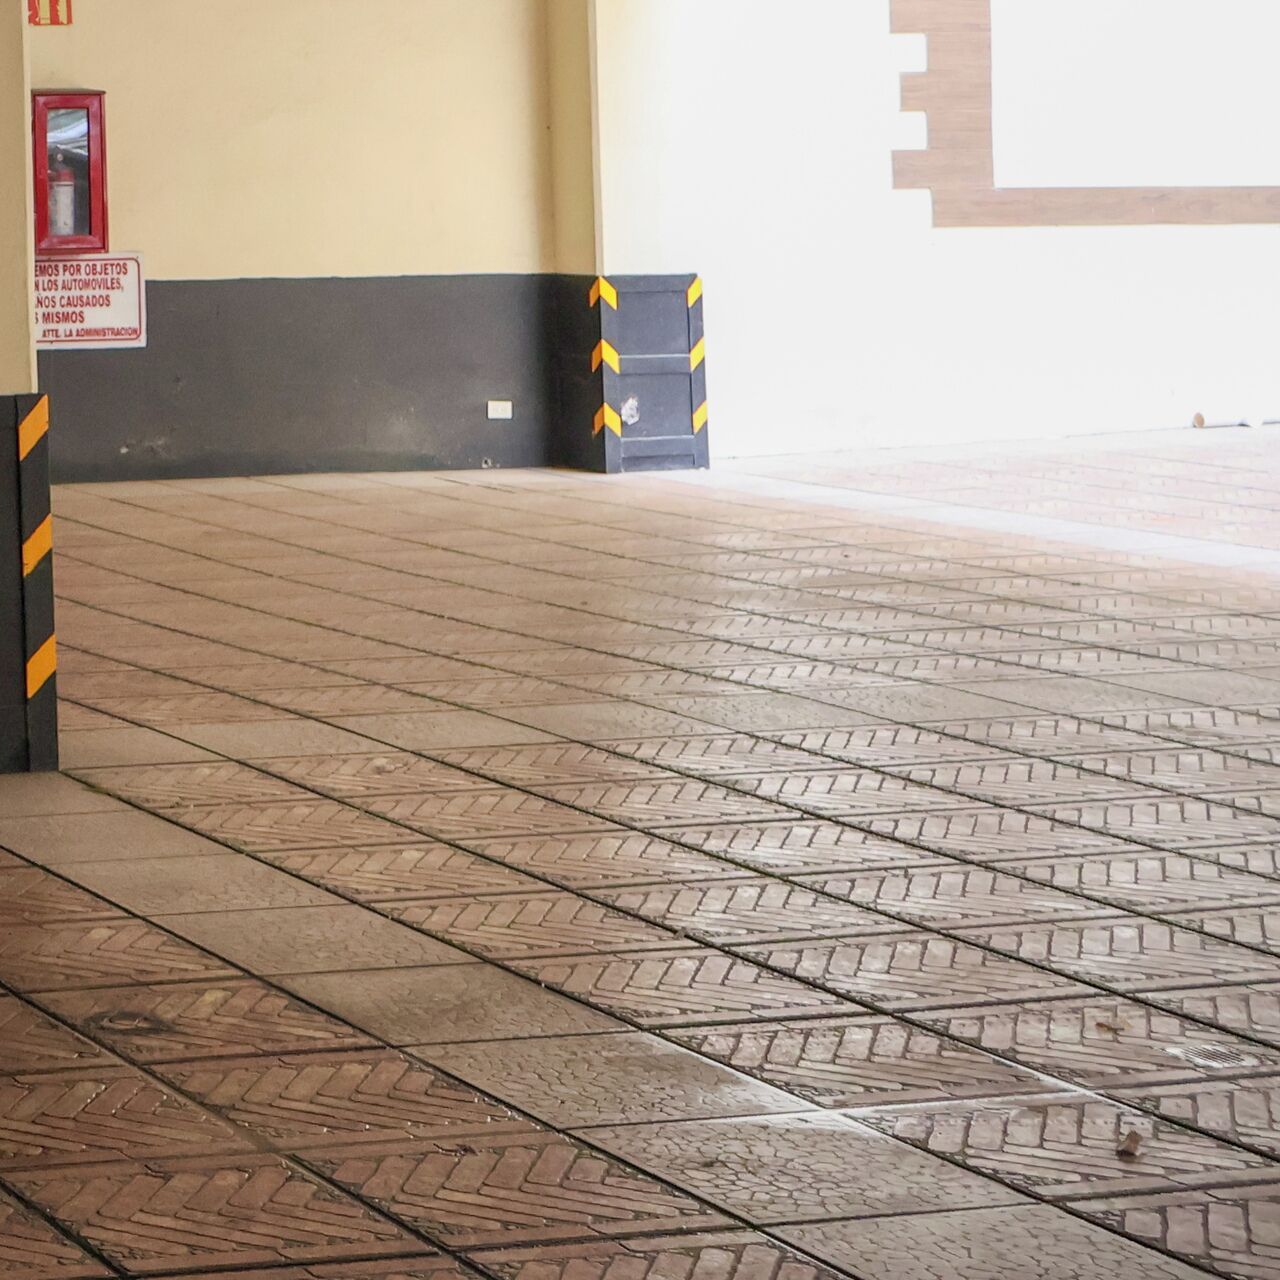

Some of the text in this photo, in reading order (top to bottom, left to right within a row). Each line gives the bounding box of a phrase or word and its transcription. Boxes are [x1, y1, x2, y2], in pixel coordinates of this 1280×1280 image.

[62, 264, 81, 276] POR
[84, 262, 128, 276] OBJETOS
[42, 279, 58, 291] LOS
[59, 294, 110, 308] CAUSADOS
[42, 311, 85, 324] MISMOS
[64, 328, 73, 337] LA
